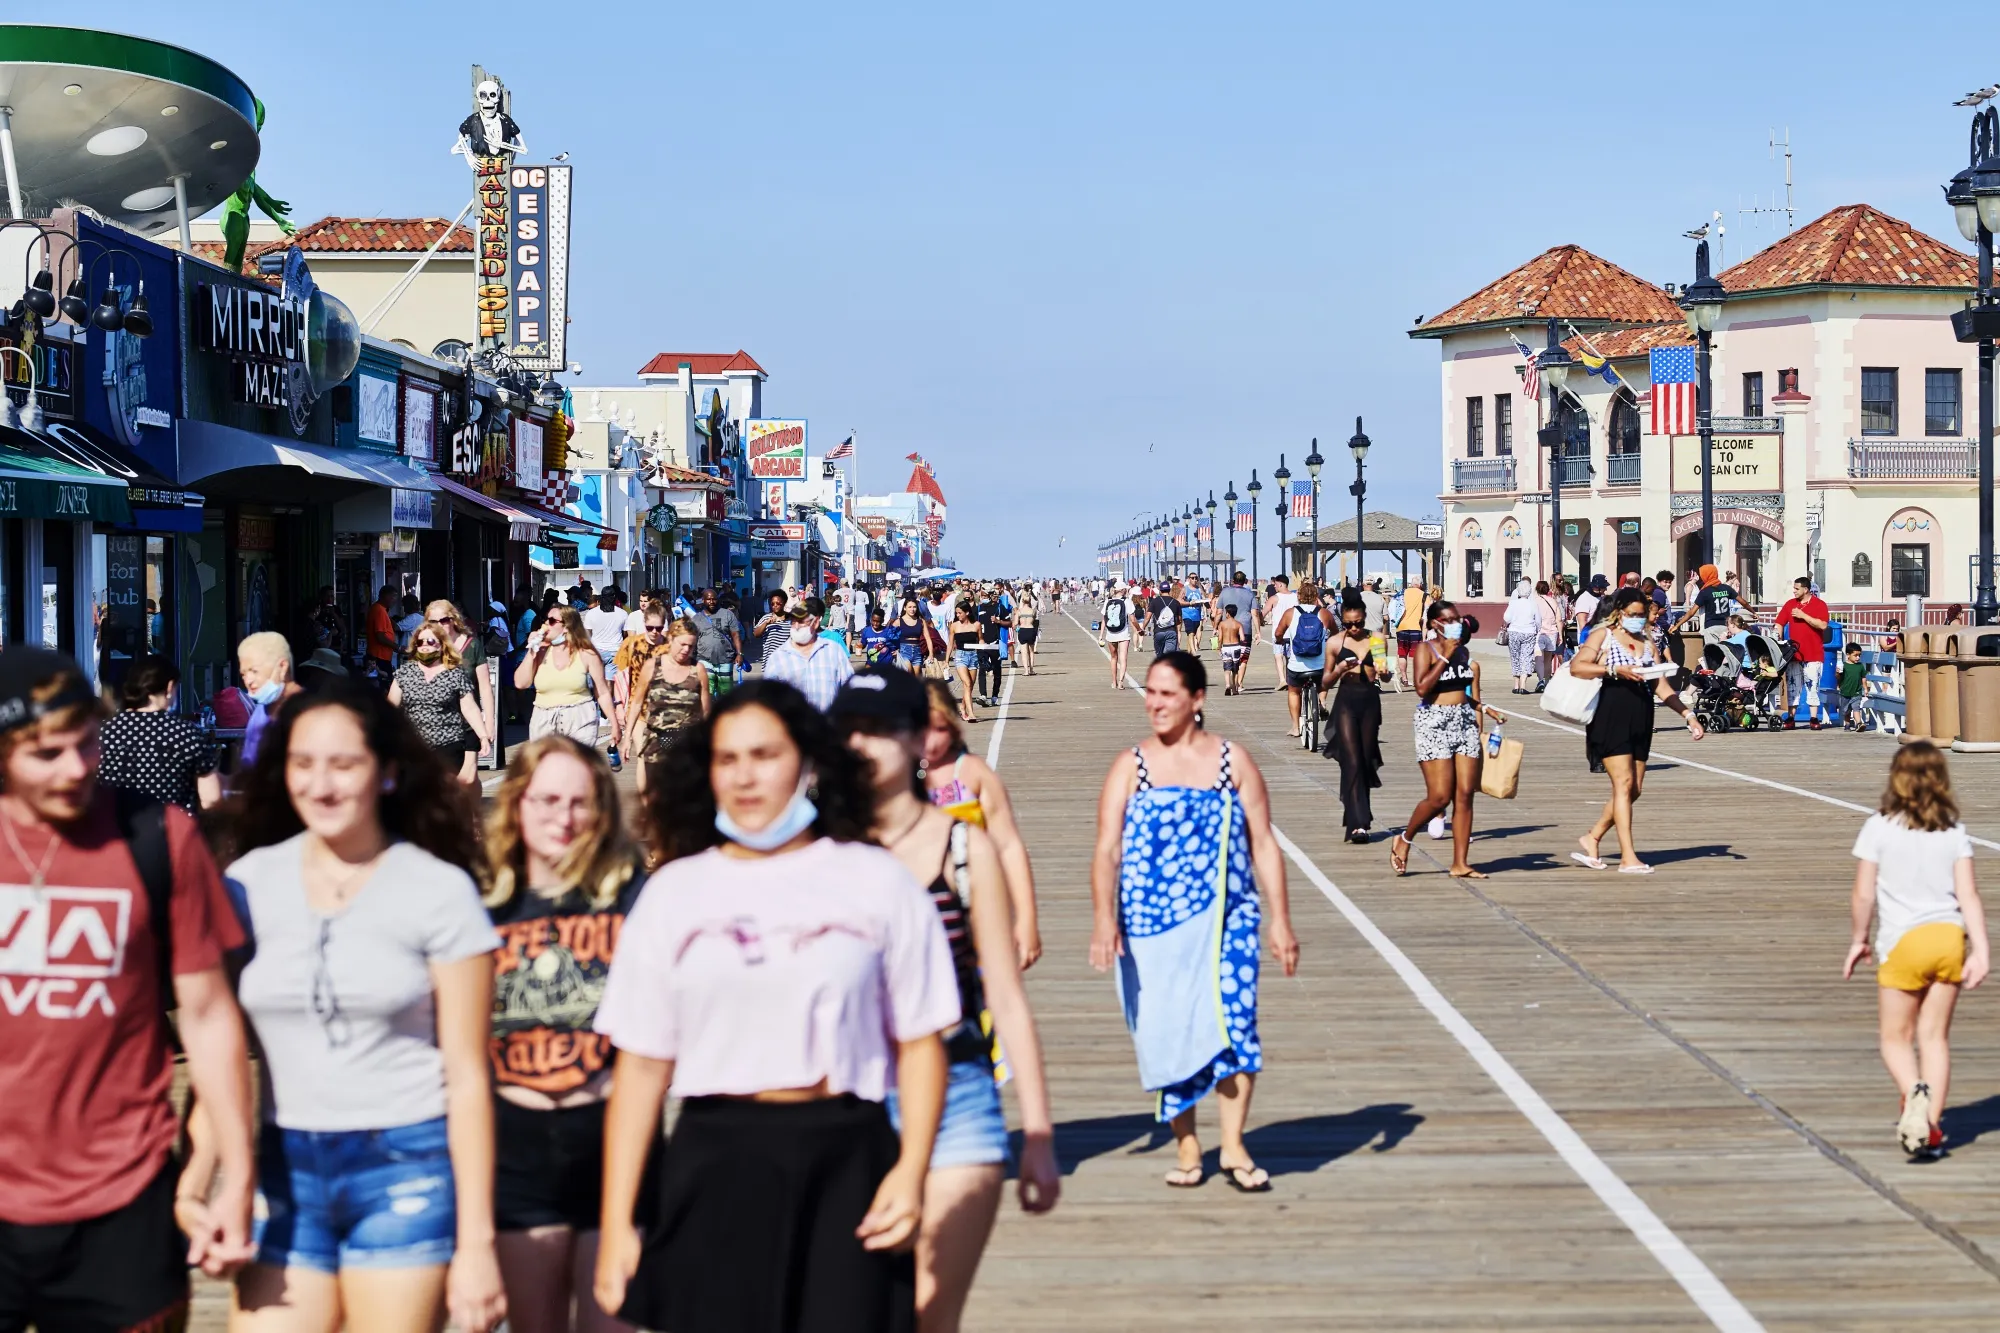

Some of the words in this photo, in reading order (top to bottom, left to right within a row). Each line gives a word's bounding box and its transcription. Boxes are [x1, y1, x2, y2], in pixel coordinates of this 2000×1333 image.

[511, 168, 546, 188] OC
[477, 156, 508, 278] HAUNTED
[516, 193, 543, 343] ESCAPE
[211, 284, 306, 362] MIRROR
[477, 284, 508, 338] GOLF
[0, 336, 70, 390] HADES
[245, 362, 288, 407] MAZE
[452, 422, 481, 474] ESC
[749, 426, 804, 460] HOLLYWOOD
[1701, 439, 1754, 450] ELCOME
[751, 458, 802, 477] ARCADE
[1693, 464, 1731, 475] OEAN
[1734, 464, 1759, 475] CITY
[1719, 451, 1734, 462] TO
[56, 485, 90, 514] DINNER
[1713, 512, 1728, 522] ITY
[1731, 512, 1760, 525] MUSIC
[1761, 520, 1781, 535] PIER
[109, 562, 138, 579] for
[108, 587, 139, 606] tub
[1713, 597, 1729, 615] 12
[1439, 666, 1457, 681] ach
[0, 976, 117, 1019] VCA
